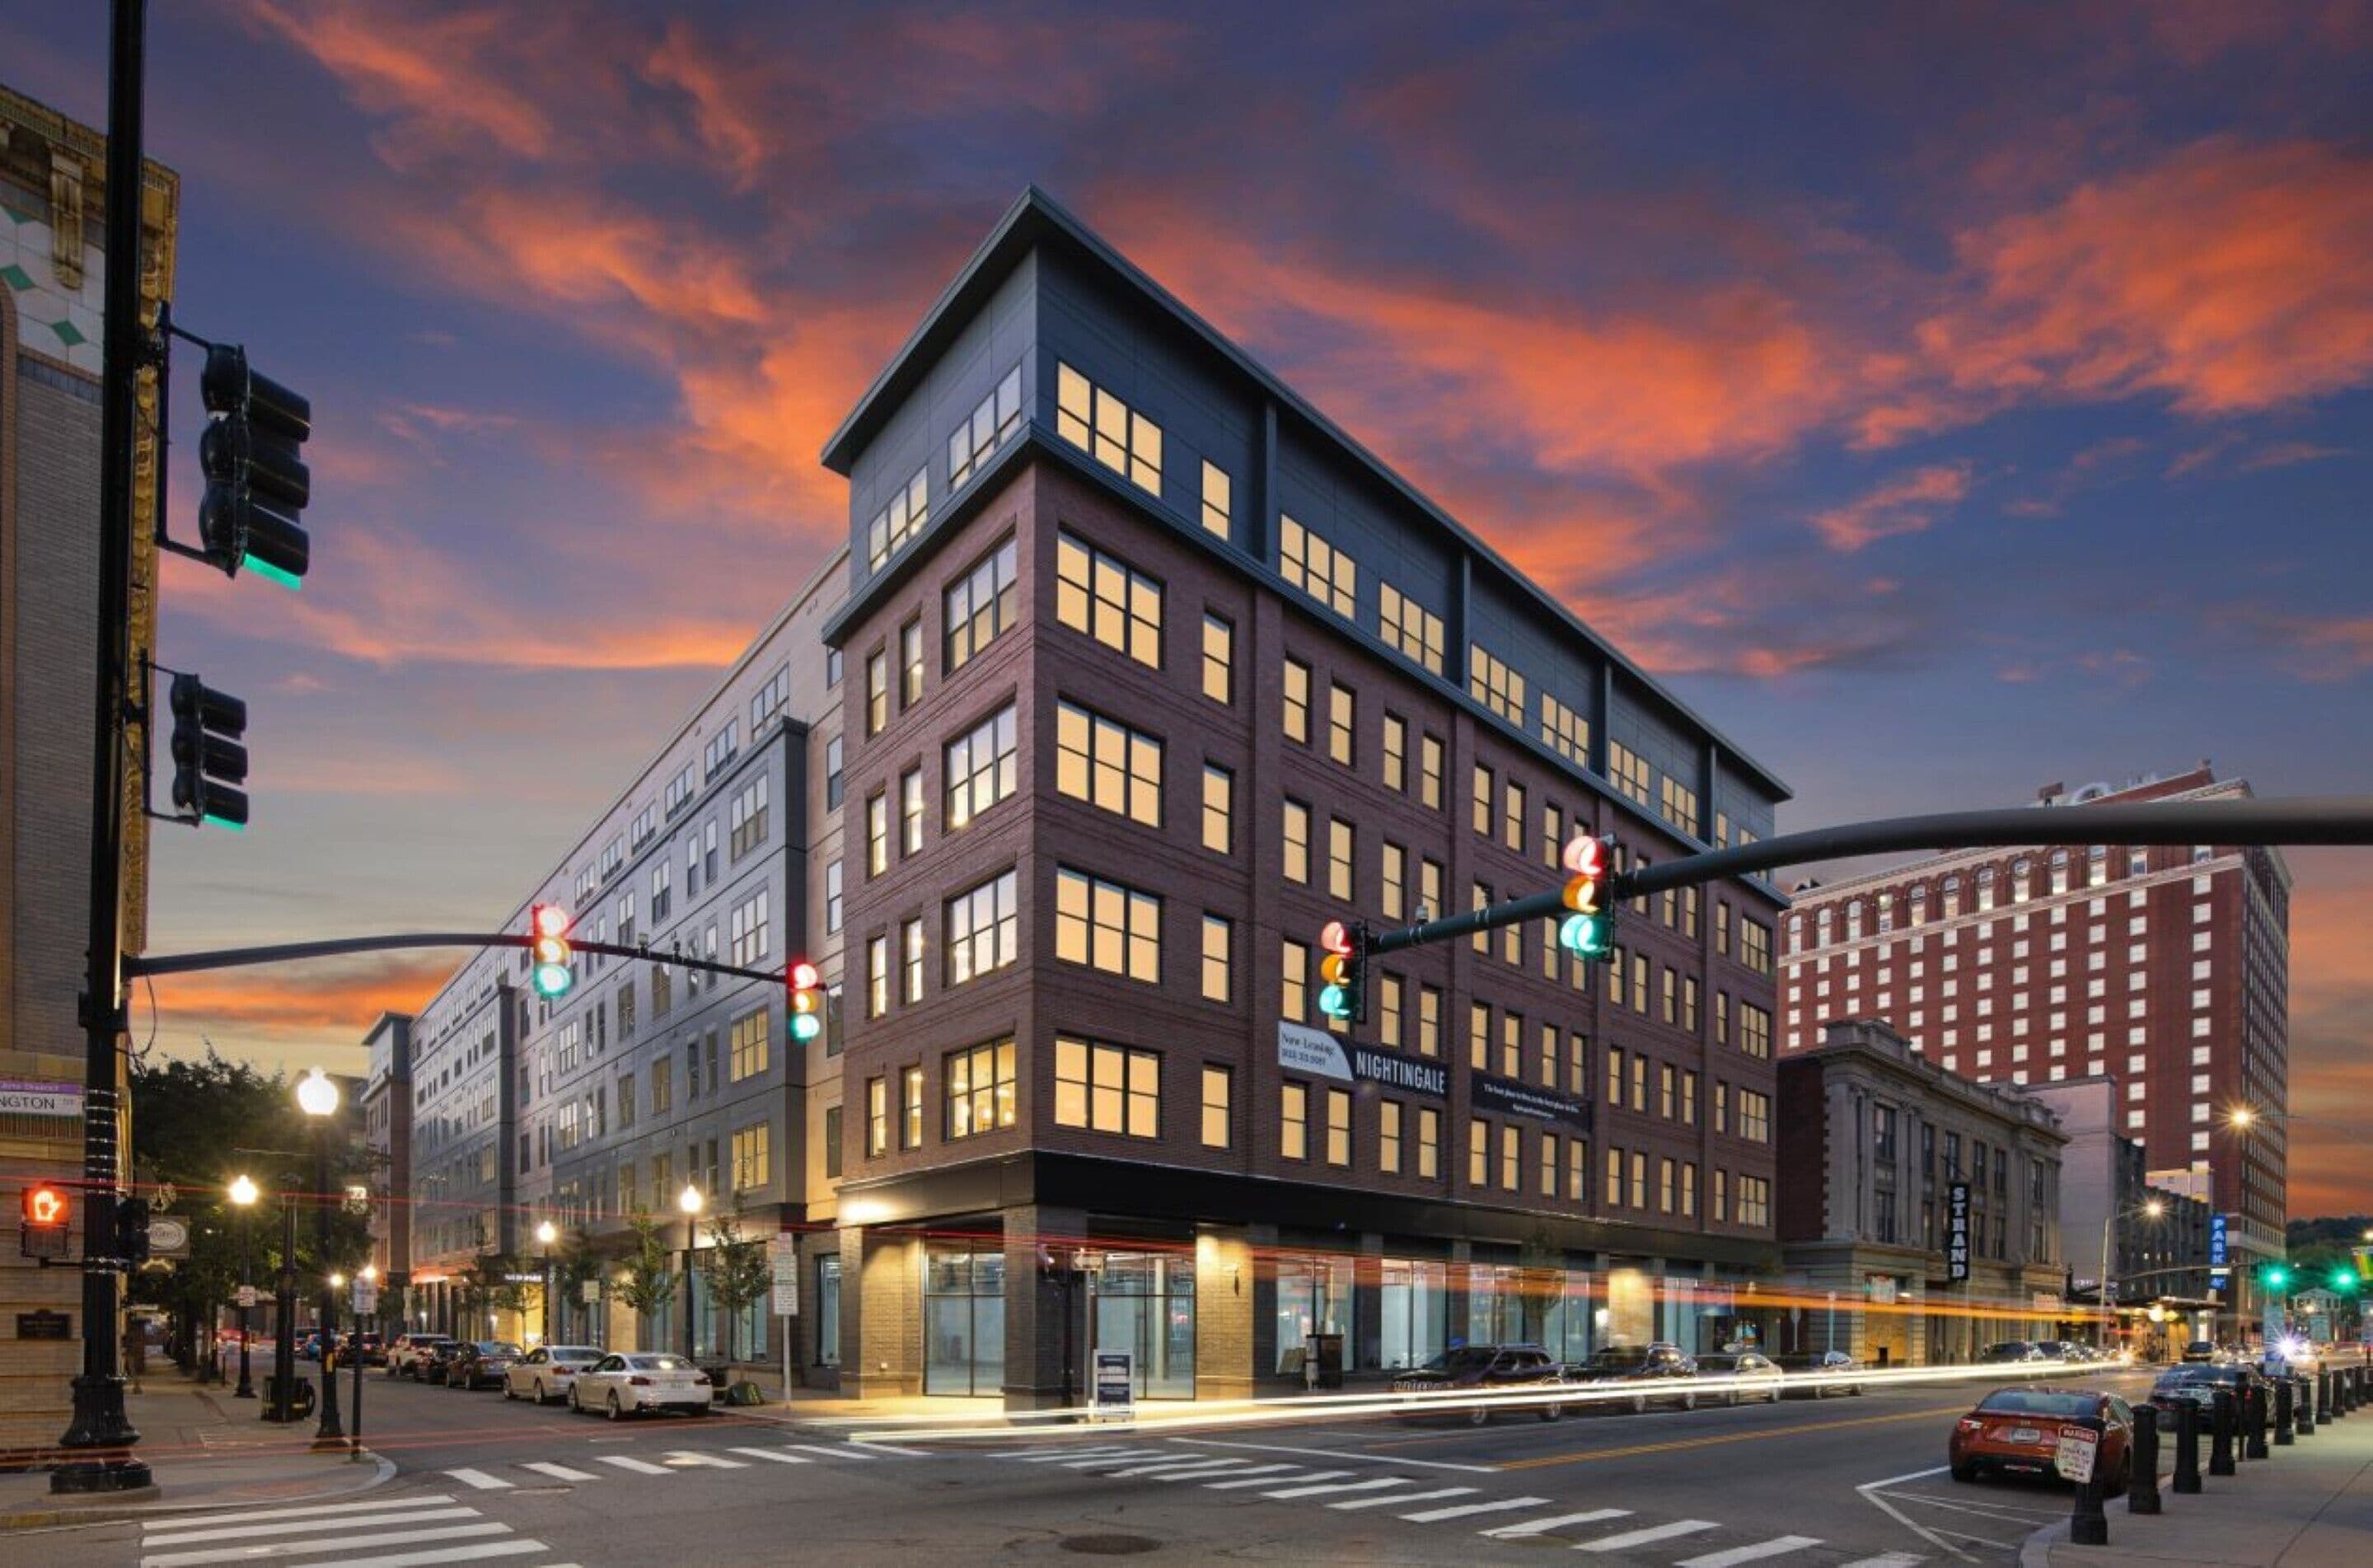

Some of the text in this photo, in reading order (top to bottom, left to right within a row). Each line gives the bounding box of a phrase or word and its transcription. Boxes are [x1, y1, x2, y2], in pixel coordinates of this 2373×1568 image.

[1356, 1051, 1445, 1093] NIGHTINGALE
[1951, 1187, 1967, 1278] STRAND
[2212, 1219, 2225, 1266] PARK
